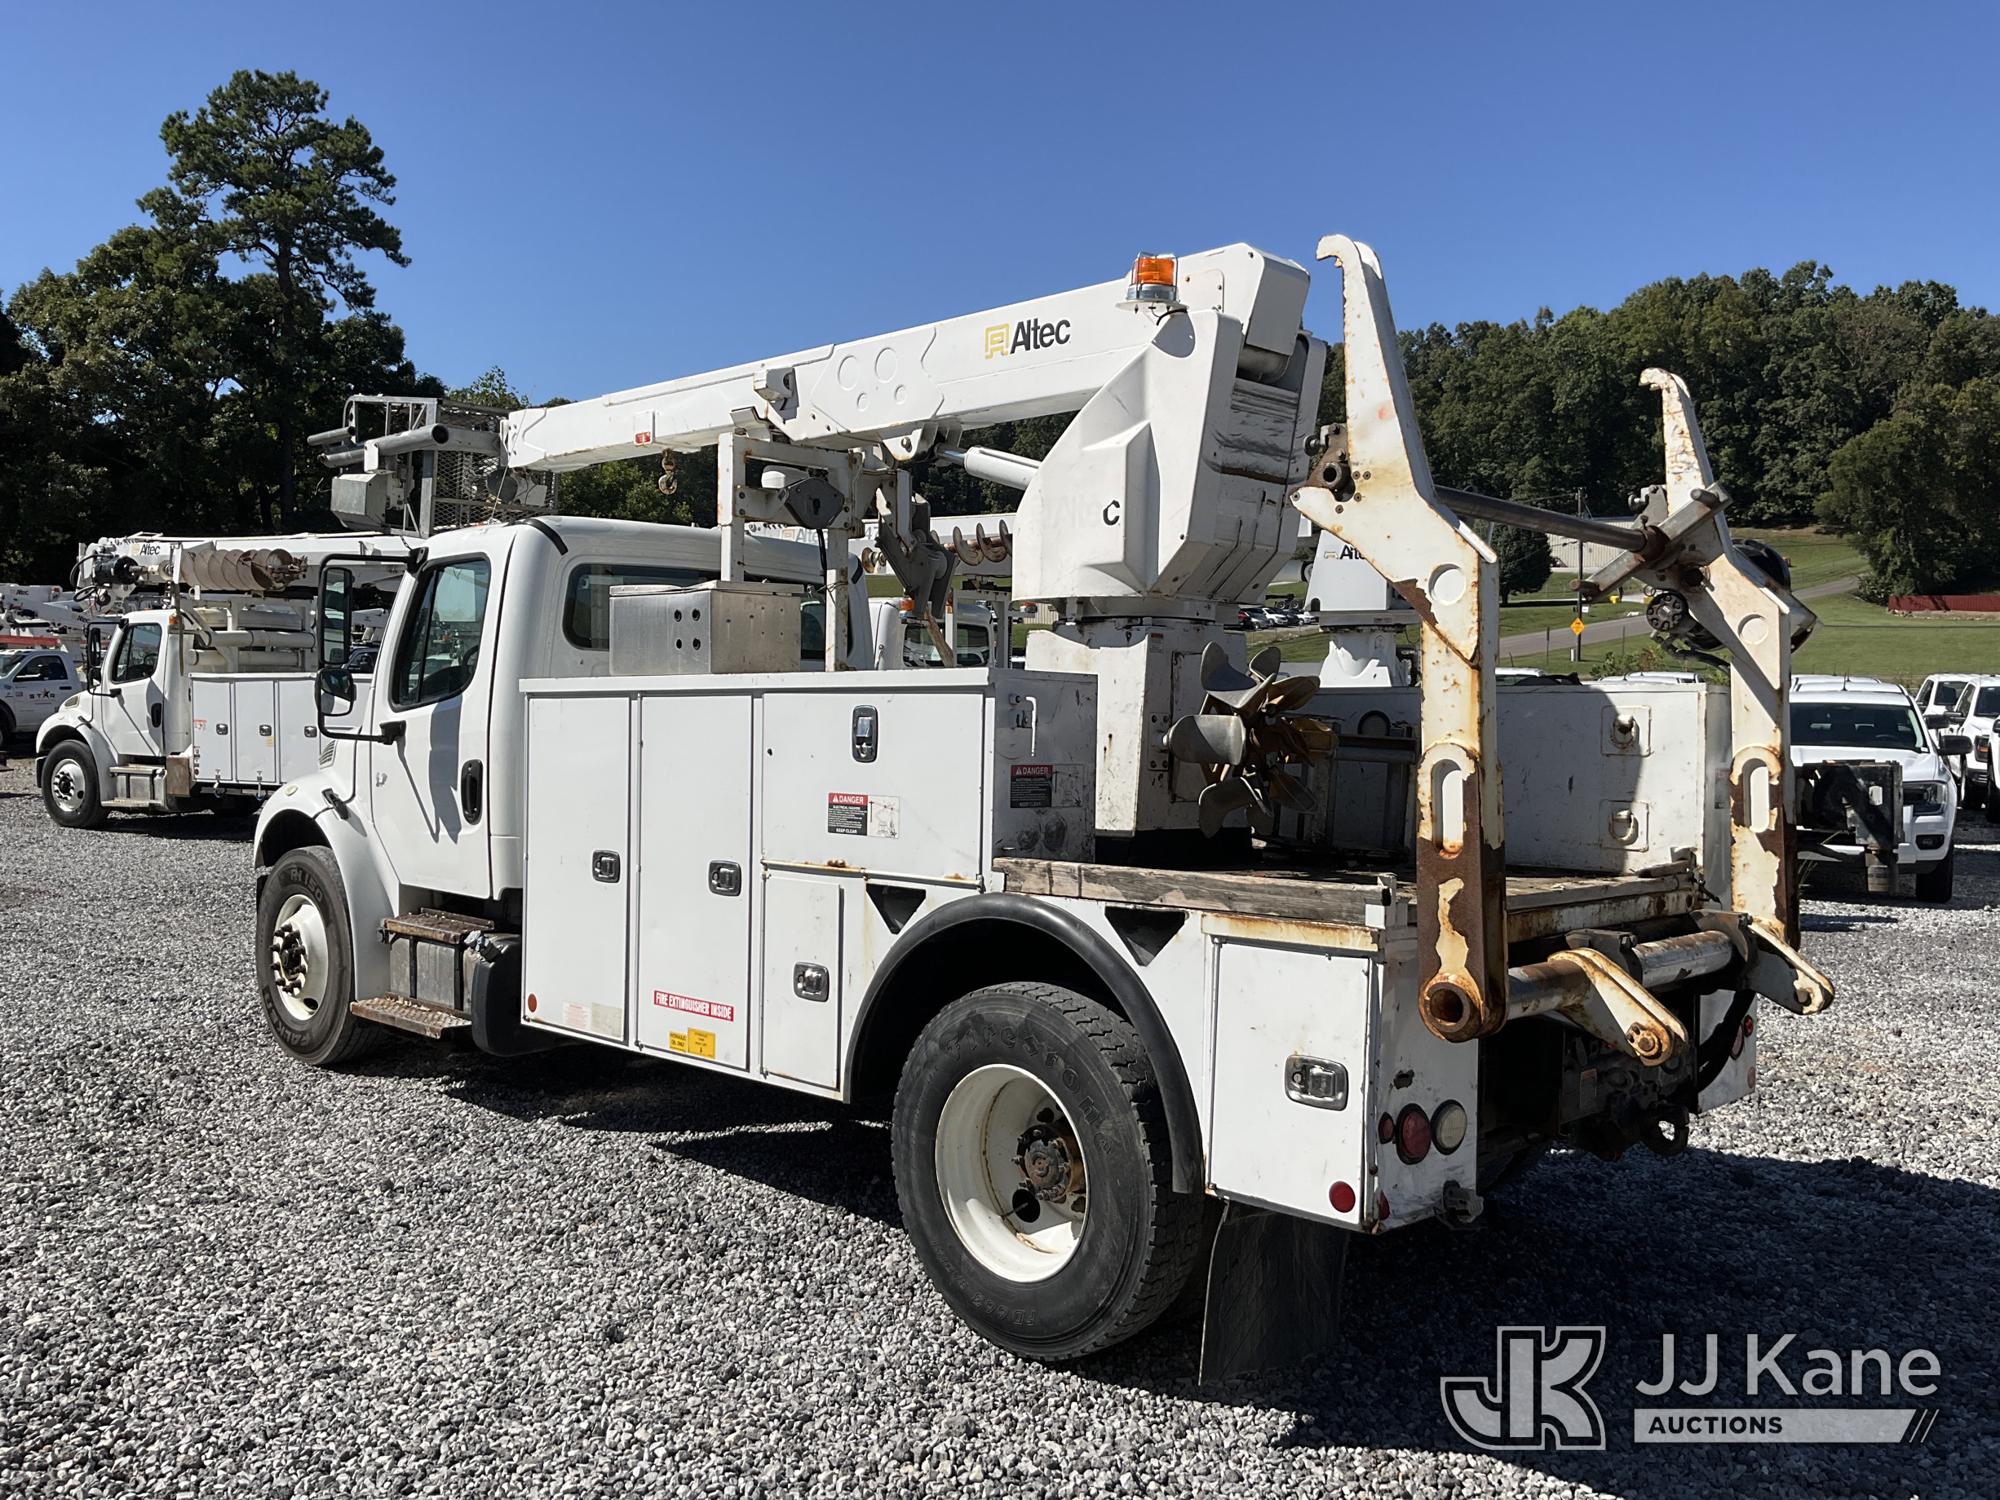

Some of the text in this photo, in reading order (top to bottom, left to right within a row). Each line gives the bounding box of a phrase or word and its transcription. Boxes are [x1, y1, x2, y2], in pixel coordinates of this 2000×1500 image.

[1010, 317, 1071, 355] Altec
[140, 543, 161, 556] Altec
[1339, 544, 1365, 560] Alt
[1022, 766, 1049, 775] DANGER
[838, 795, 864, 805] DANGER
[656, 991, 732, 1020] FIRE EXTINGUISHER INSIDE
